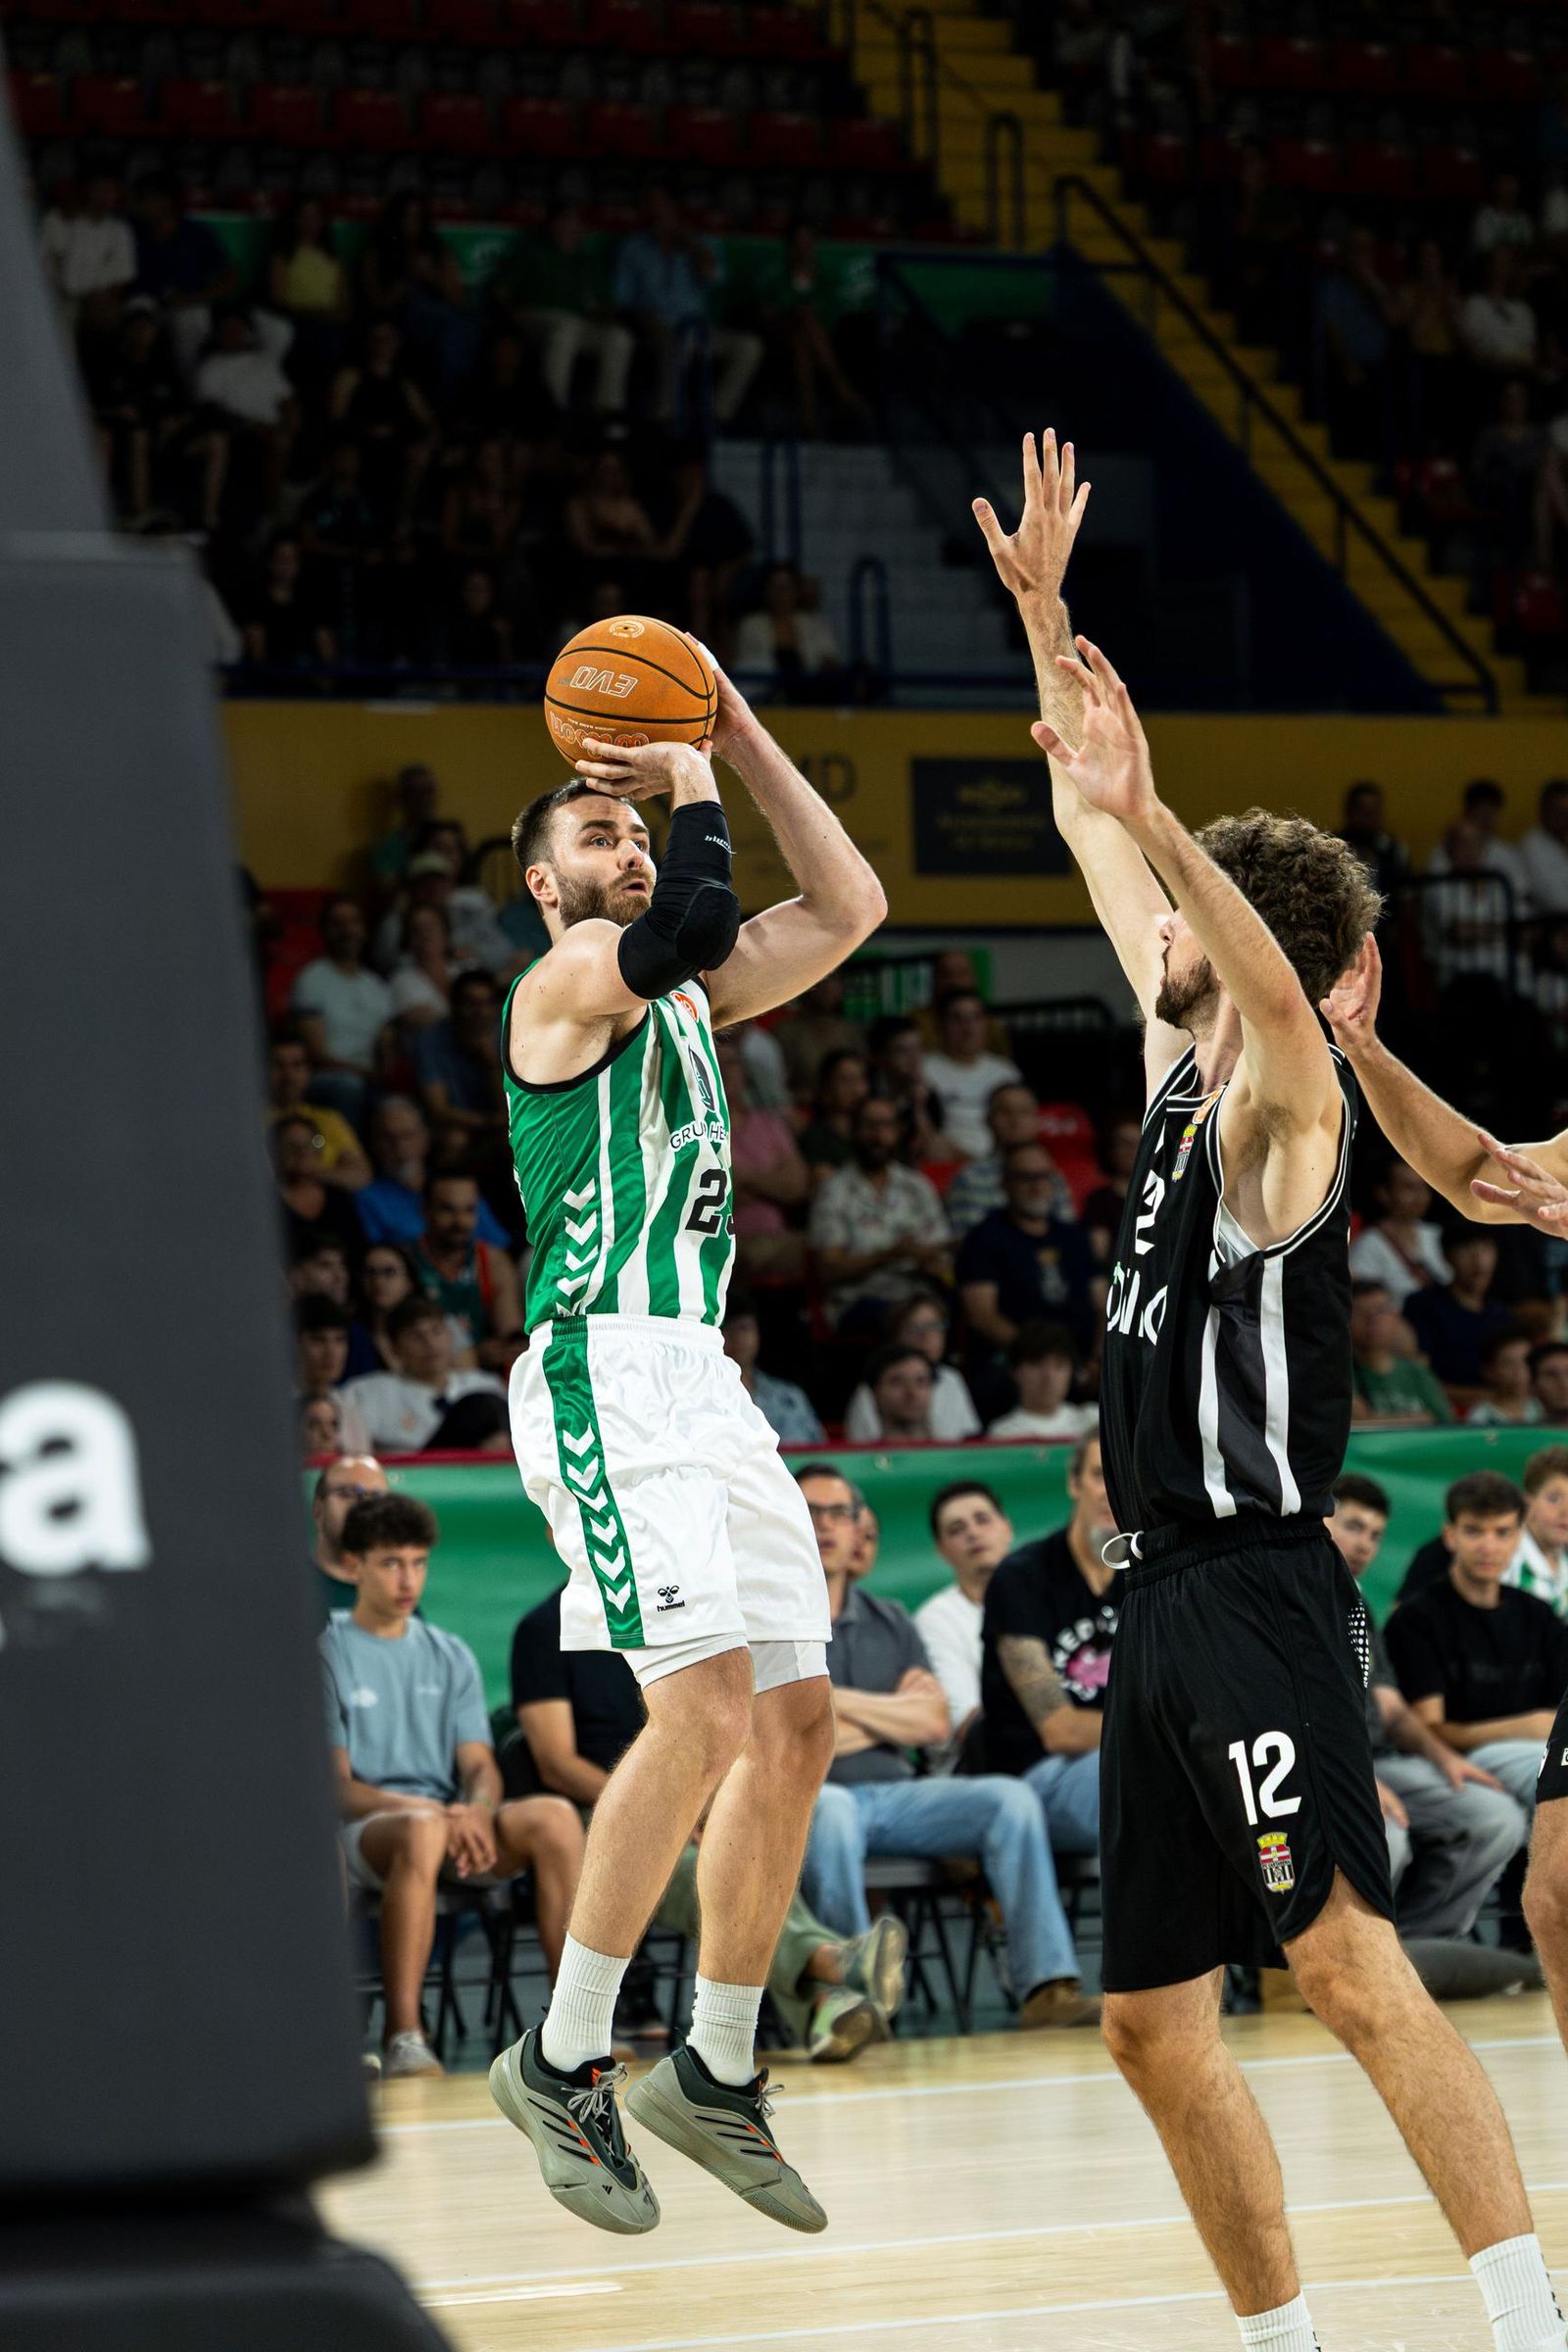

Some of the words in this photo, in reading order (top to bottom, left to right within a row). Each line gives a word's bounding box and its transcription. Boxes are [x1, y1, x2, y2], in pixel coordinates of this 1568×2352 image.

[570, 666, 638, 698] EVO
[670, 1122, 707, 1150] GRU
[710, 1124, 729, 1141] HE
[657, 1600, 685, 1612] hummel
[1228, 1730, 1302, 1826] 12
